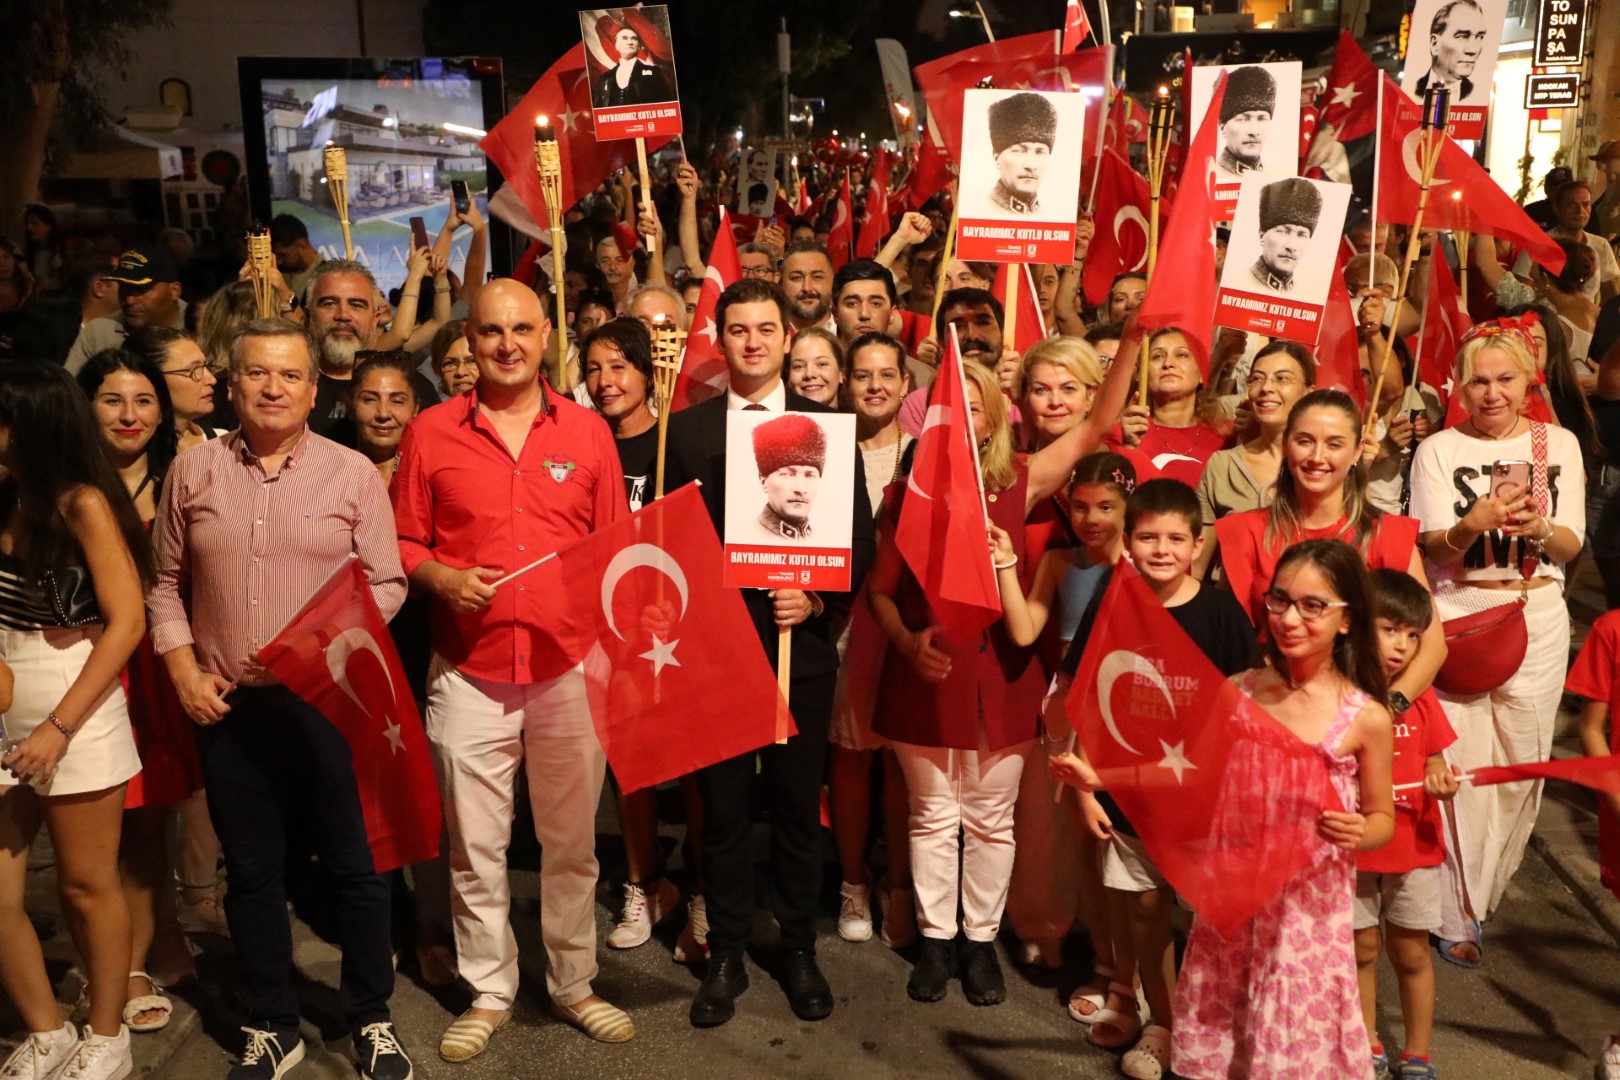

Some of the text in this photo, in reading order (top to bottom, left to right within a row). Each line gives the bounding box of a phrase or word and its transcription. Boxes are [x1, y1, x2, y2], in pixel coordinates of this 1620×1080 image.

[1551, 0, 1570, 11] TO
[1549, 13, 1577, 25] SUN
[1547, 28, 1566, 39] PA
[1546, 41, 1565, 55] ŞA
[637, 110, 656, 120] KUTLU
[657, 108, 677, 118] OLSUN
[1461, 112, 1482, 121] OLSUN
[962, 226, 1070, 241] BAYRAMIMIZ KUTLU OLSUN
[1221, 294, 1317, 322] BAYRAMIMIZ KUTLU OLSUN
[730, 551, 845, 568] BAYRAMIMIZ KUTLU OLSUN
